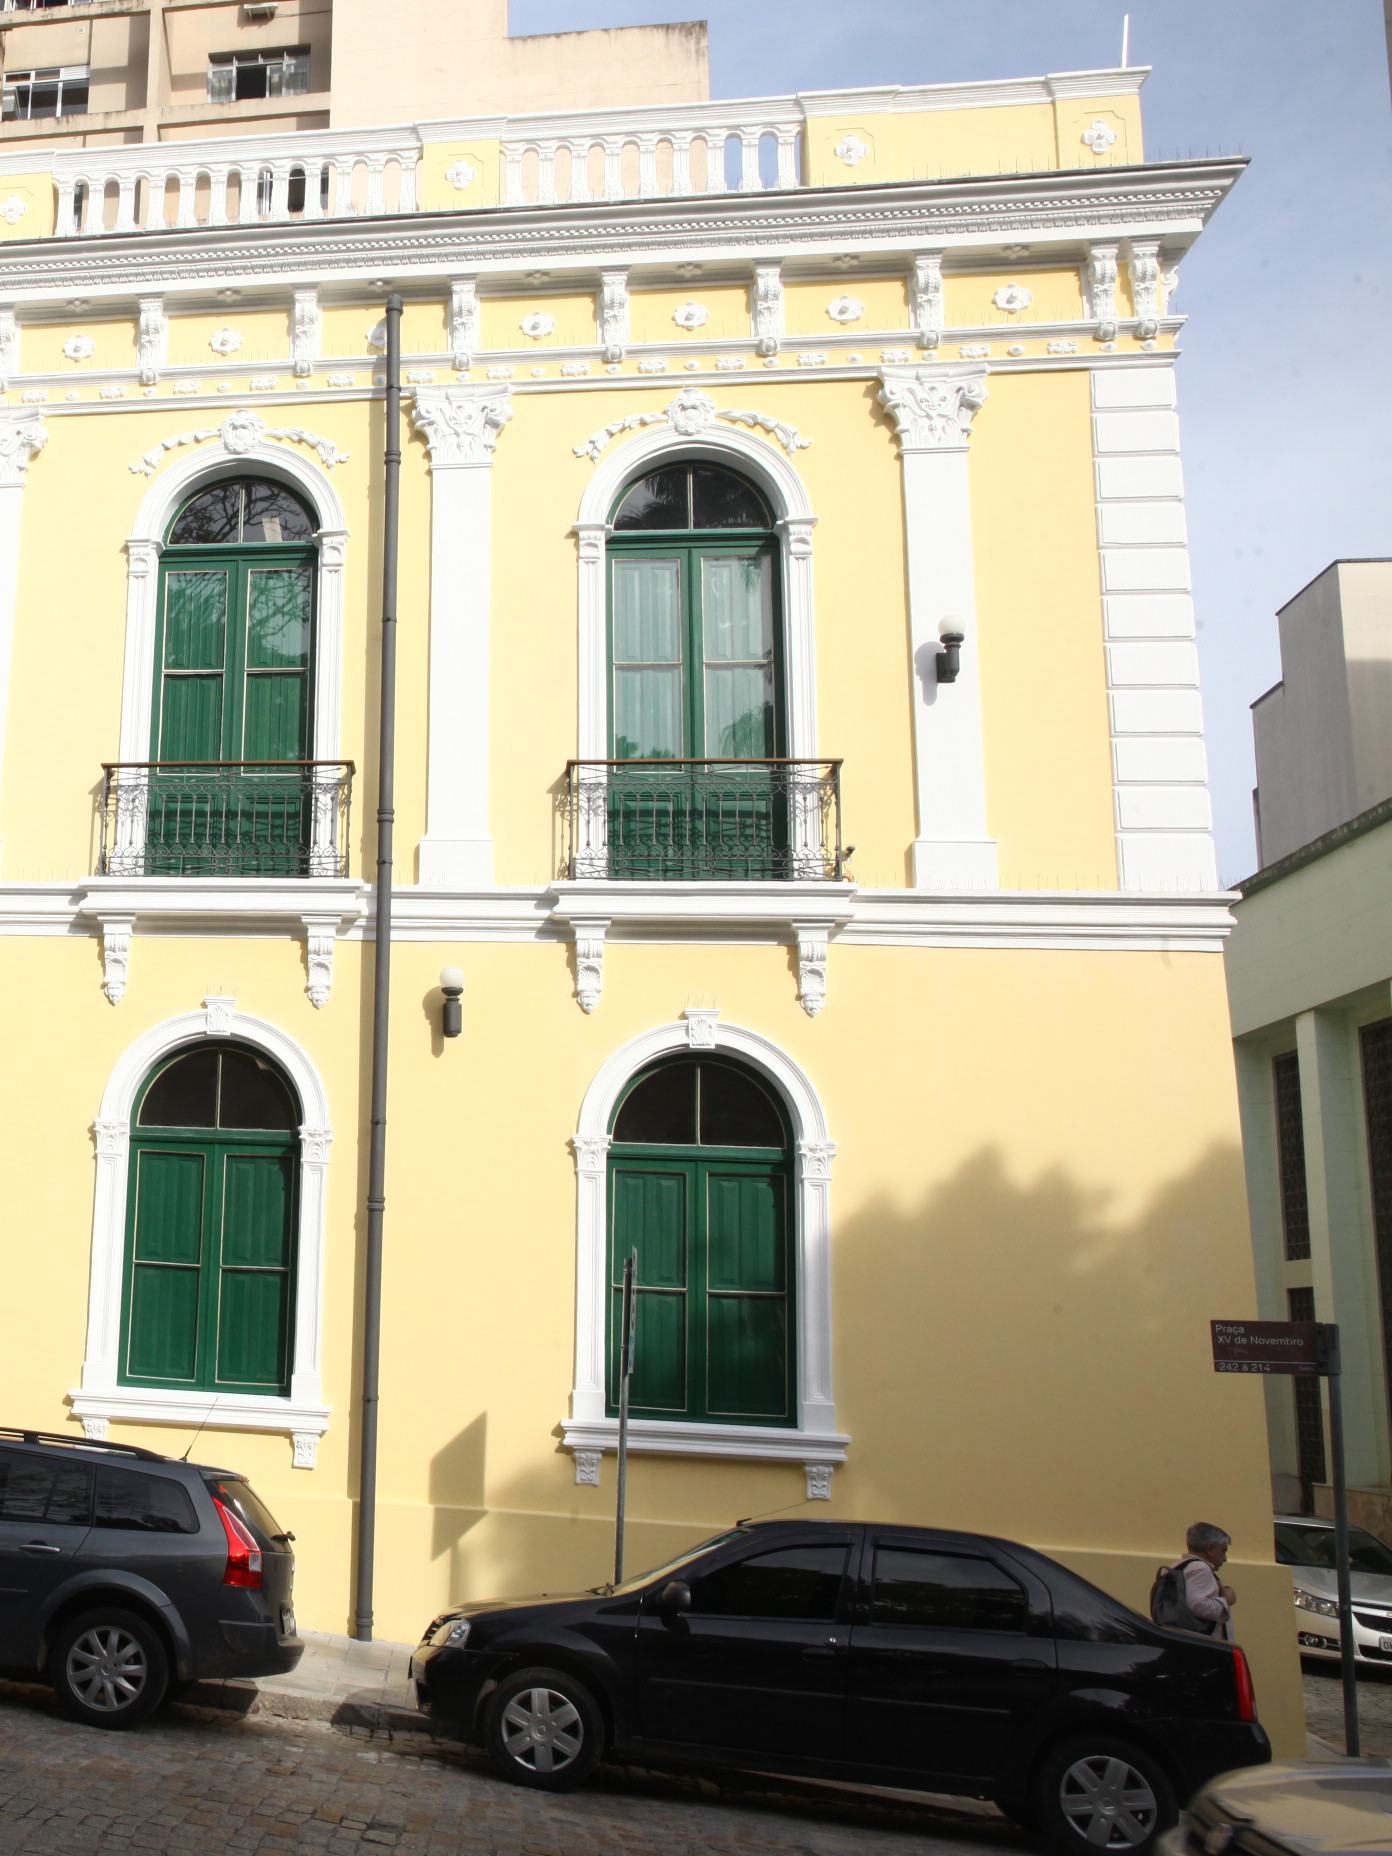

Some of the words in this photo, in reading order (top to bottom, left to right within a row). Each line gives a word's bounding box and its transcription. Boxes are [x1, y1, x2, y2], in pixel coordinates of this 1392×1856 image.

[1215, 1324, 1245, 1336] Praça
[1217, 1335, 1231, 1344] XV
[1234, 1336, 1247, 1345] de
[1250, 1336, 1304, 1346] Novembro
[1219, 1362, 1239, 1371] 242
